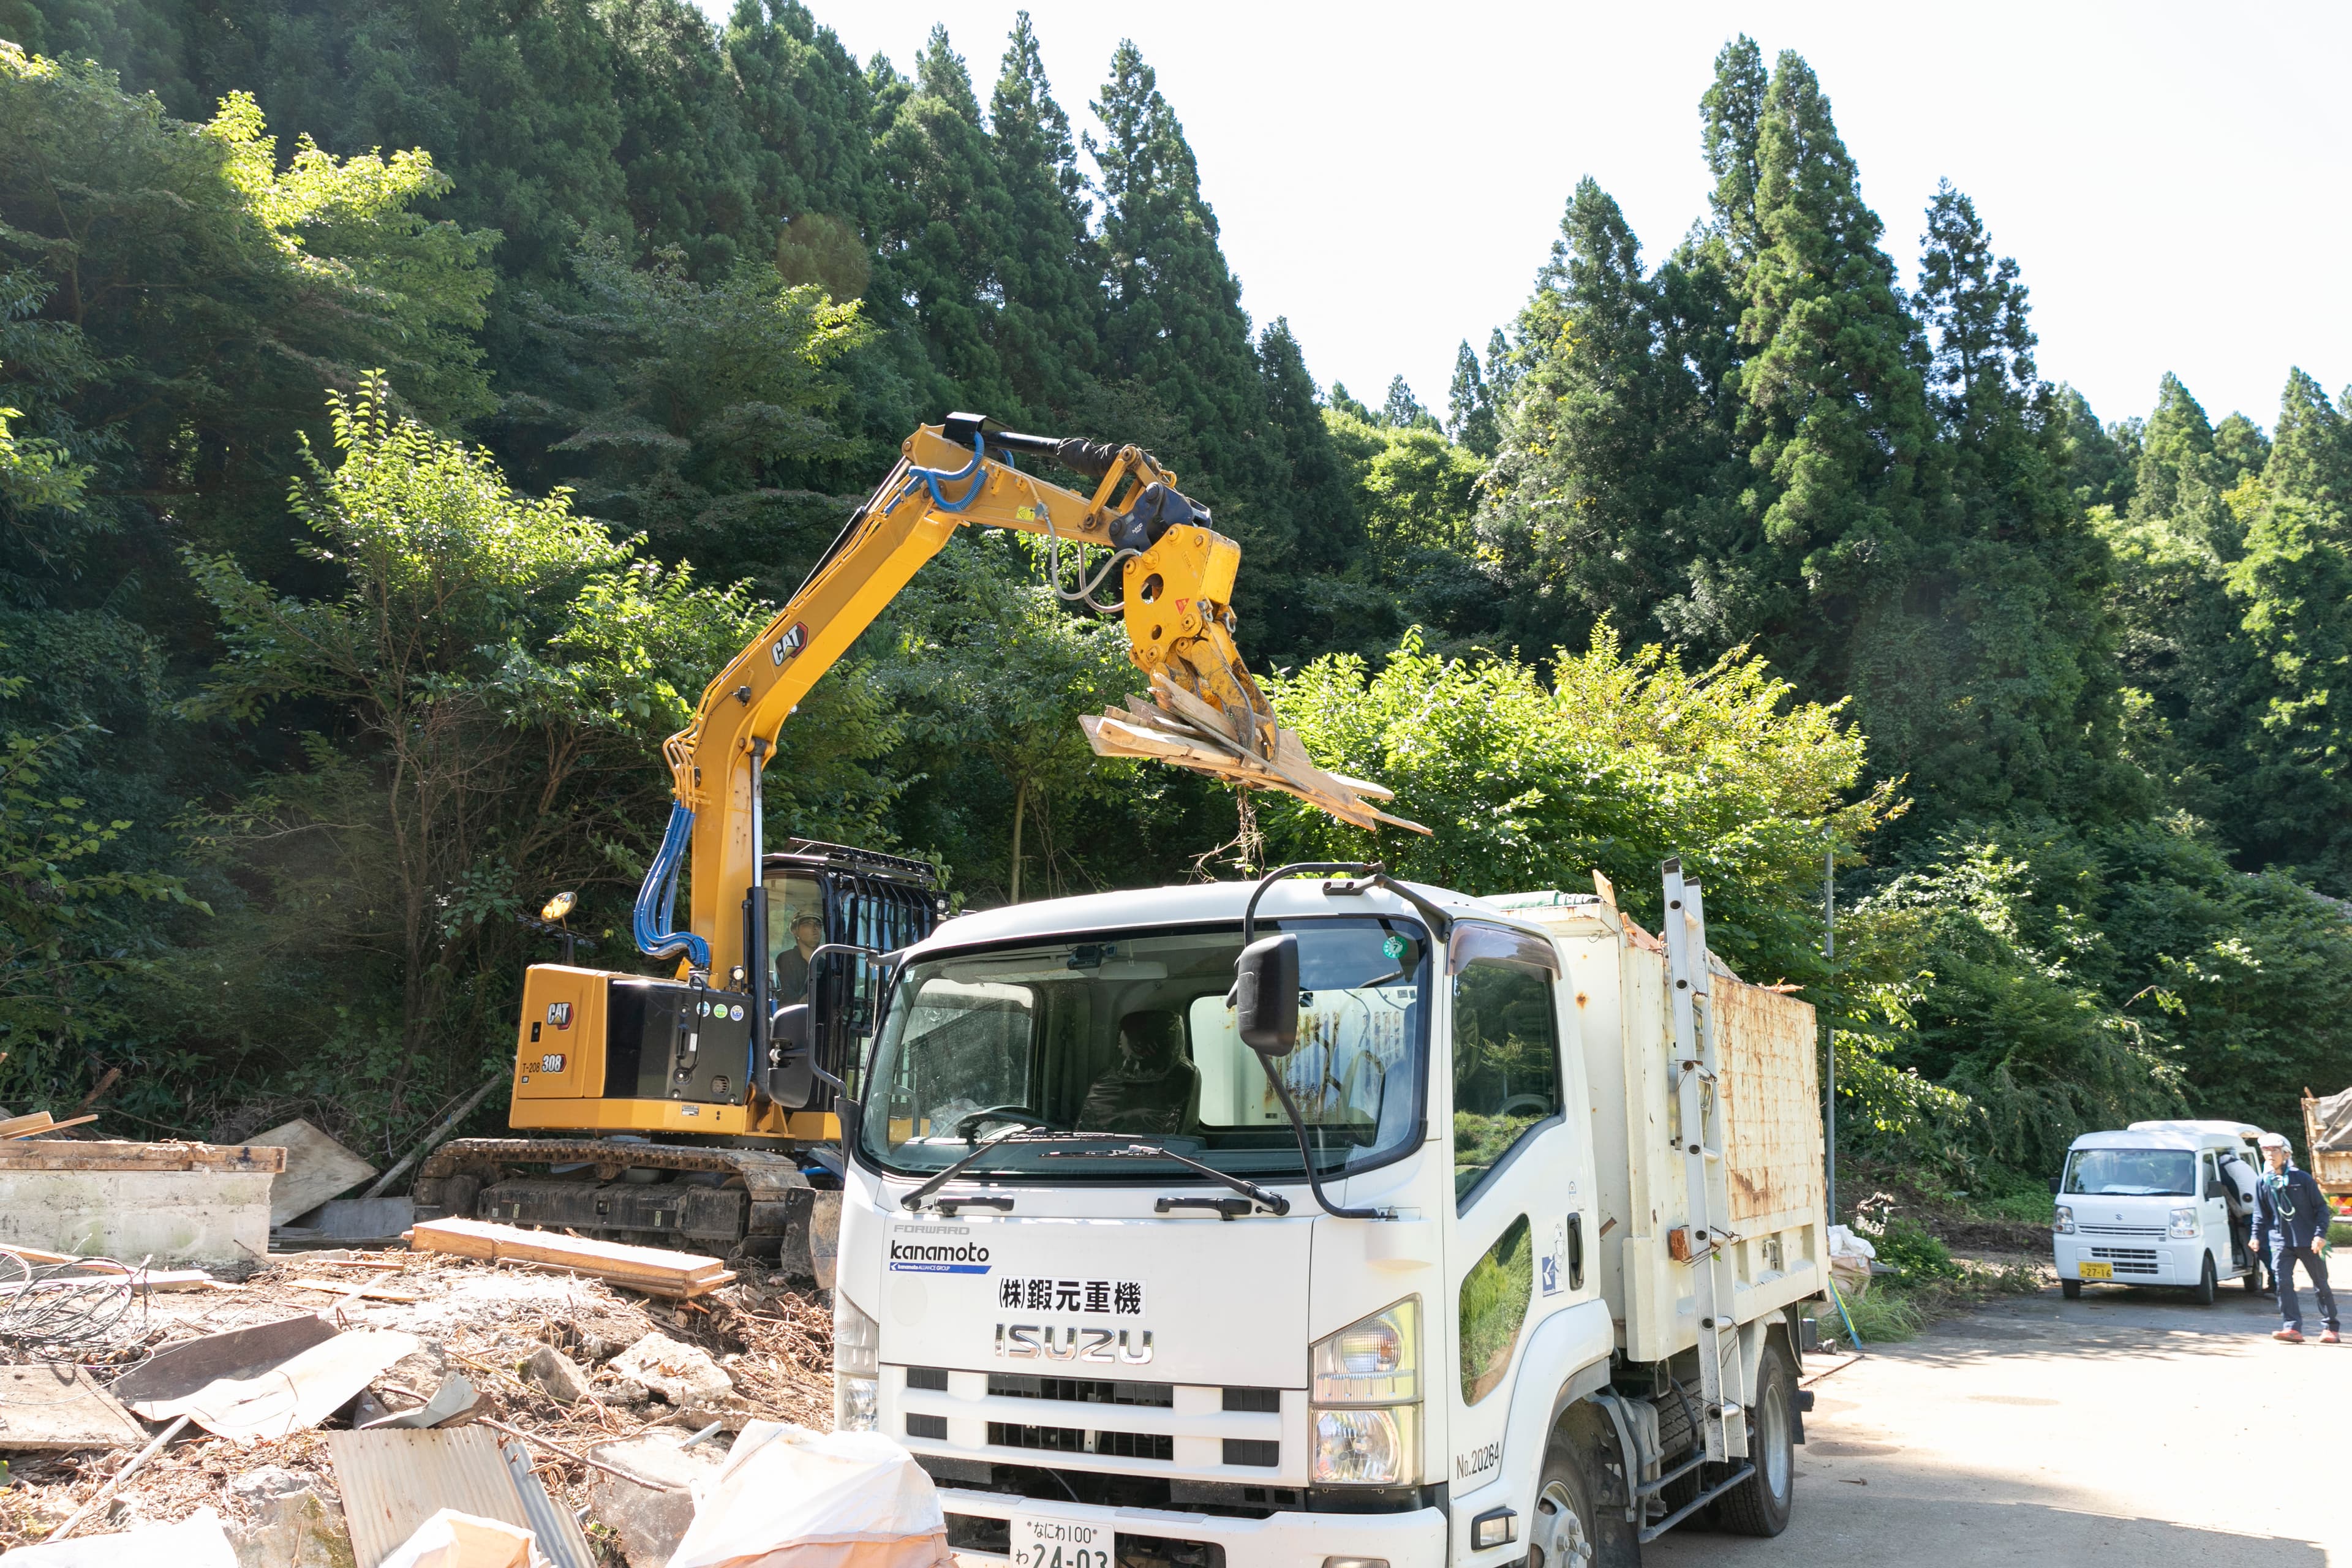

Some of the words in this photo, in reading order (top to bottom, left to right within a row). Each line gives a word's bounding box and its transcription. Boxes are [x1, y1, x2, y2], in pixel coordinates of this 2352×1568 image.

[772, 625, 800, 666] CAT
[548, 1003, 569, 1025] CAT
[522, 1062, 540, 1073] T-208
[541, 1055, 562, 1072] 308
[894, 1225, 970, 1235] FORWARD
[891, 1240, 989, 1262] kanamoto
[2087, 1268, 2111, 1278] 27-16
[995, 1323, 1154, 1365] ISUZU
[1457, 1441, 1499, 1480] No.20264
[1016, 1548, 1029, 1565] わ
[1033, 1544, 1108, 1568] 24-03
